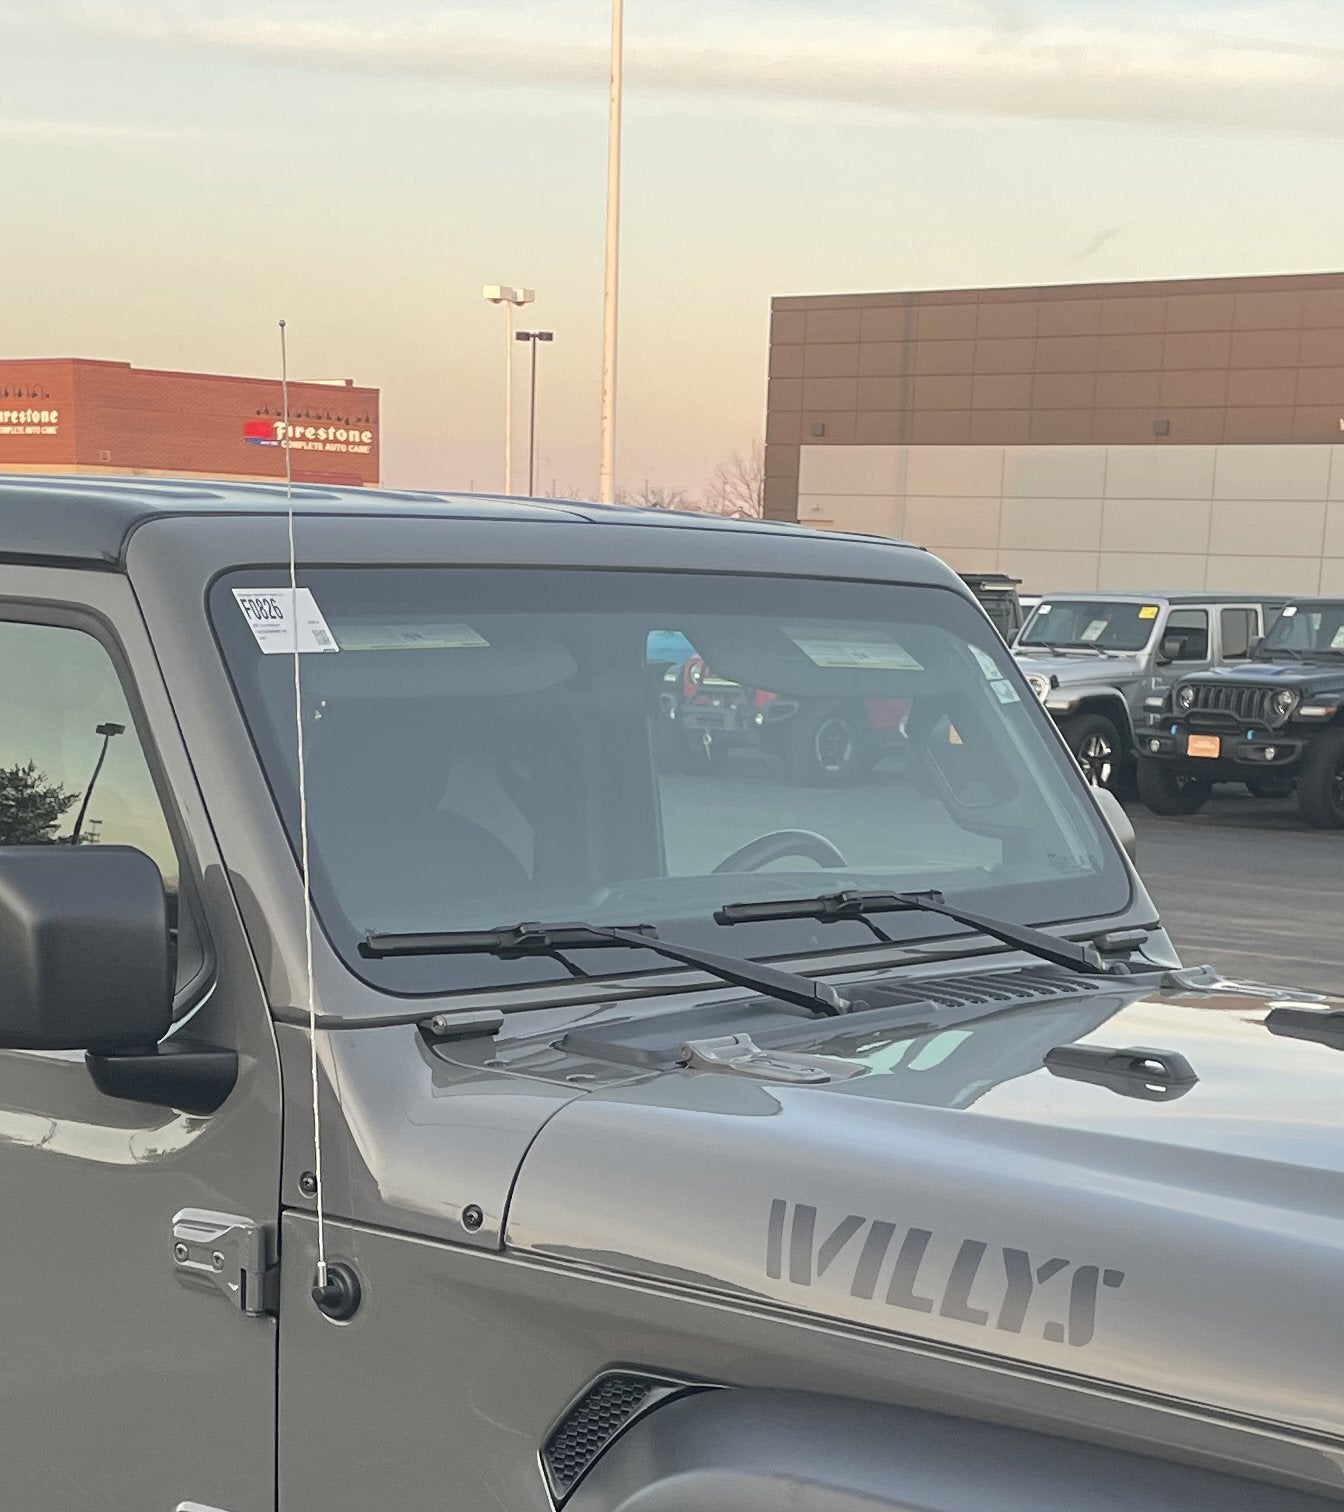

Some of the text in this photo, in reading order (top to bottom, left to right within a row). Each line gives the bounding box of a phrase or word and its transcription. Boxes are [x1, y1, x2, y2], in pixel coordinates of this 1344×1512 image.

[273, 421, 373, 443] Firestone
[239, 598, 284, 620] F0826
[766, 1198, 1126, 1348] WILLYS
